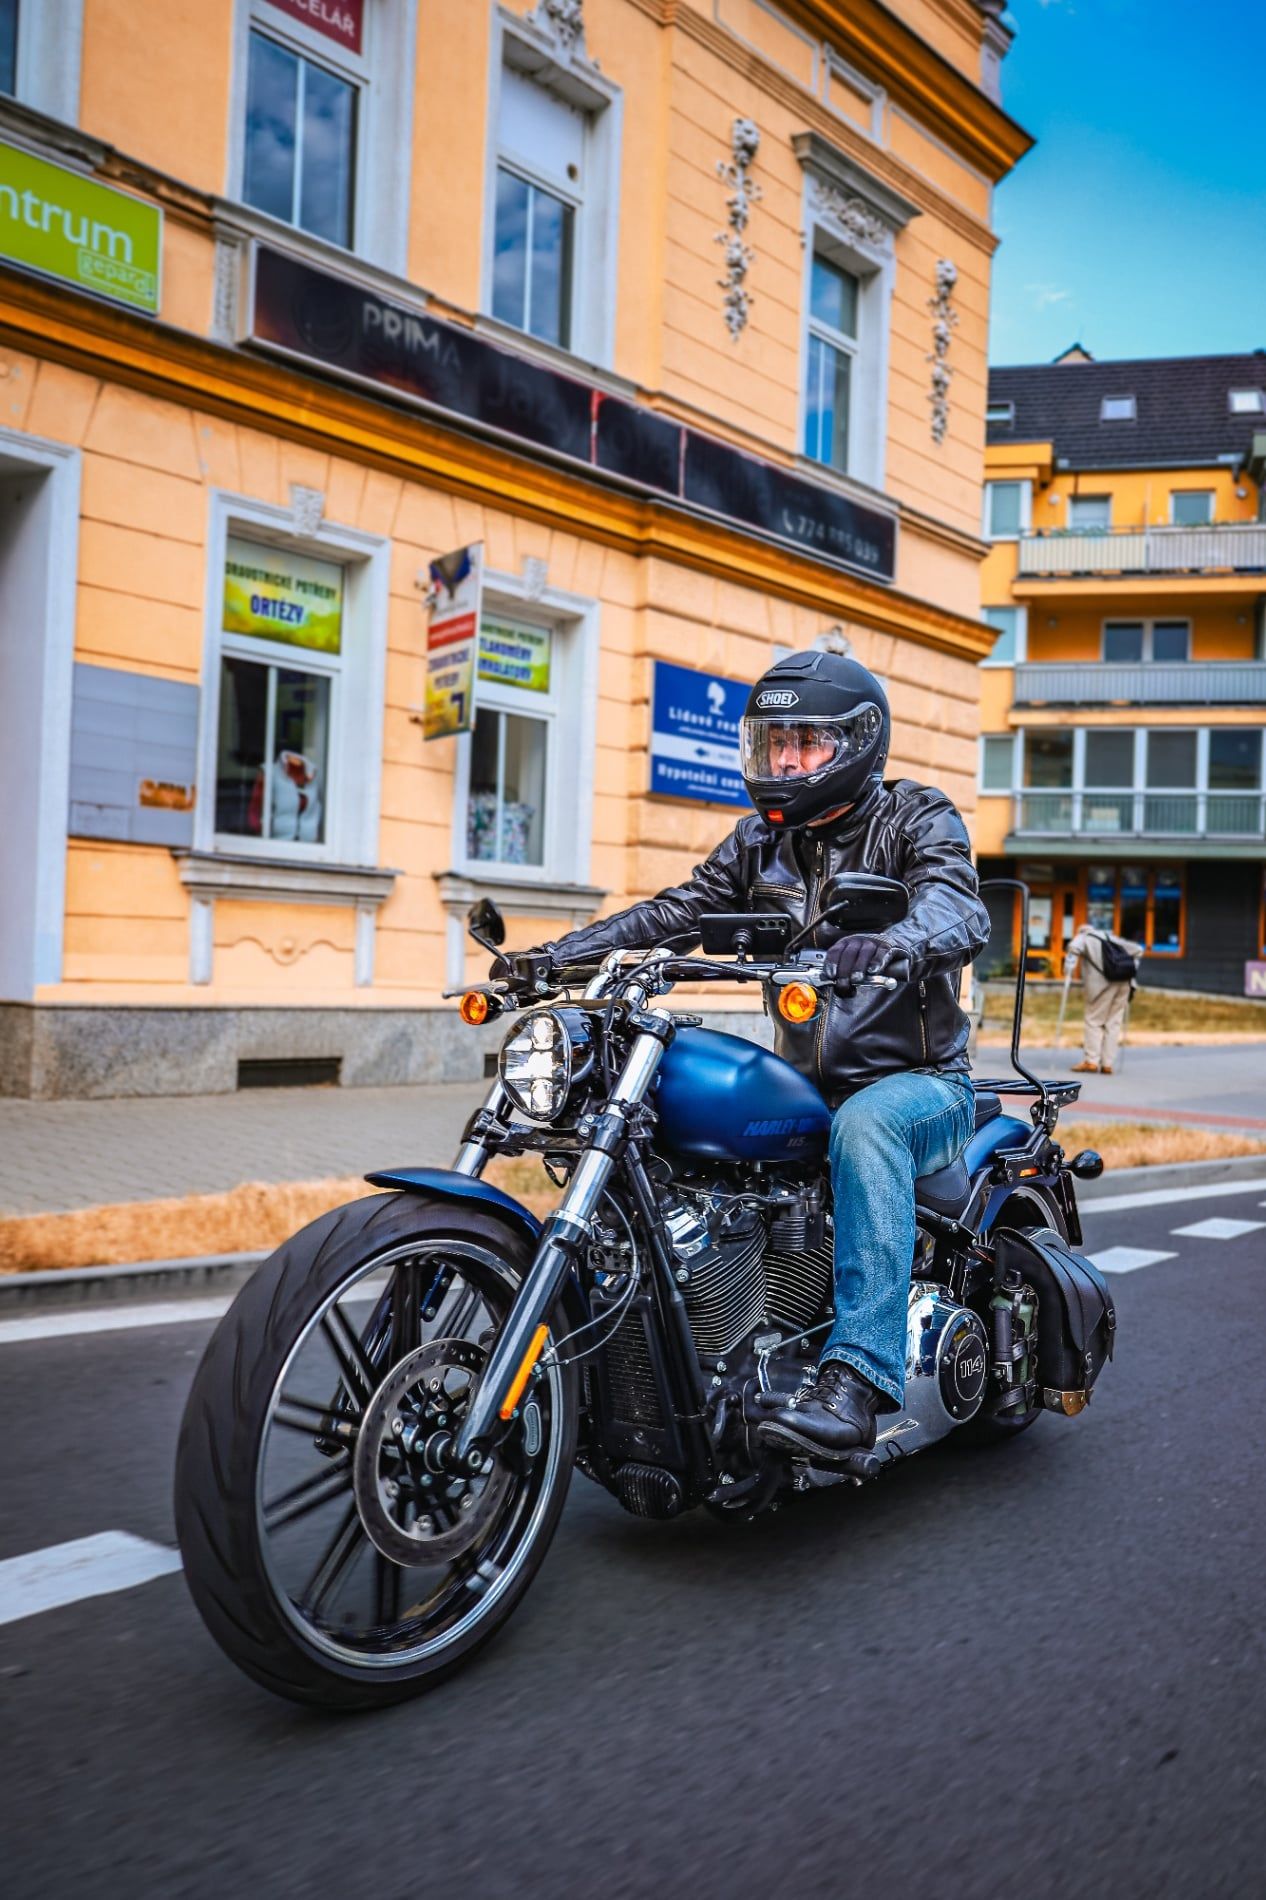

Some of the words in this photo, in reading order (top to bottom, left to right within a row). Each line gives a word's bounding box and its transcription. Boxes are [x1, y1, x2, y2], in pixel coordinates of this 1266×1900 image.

[0, 183, 133, 264] ntrum
[251, 594, 304, 624] ORTÉZY
[760, 692, 793, 706] SHOEI
[669, 706, 713, 727] Lidové
[960, 1355, 983, 1378] 114
